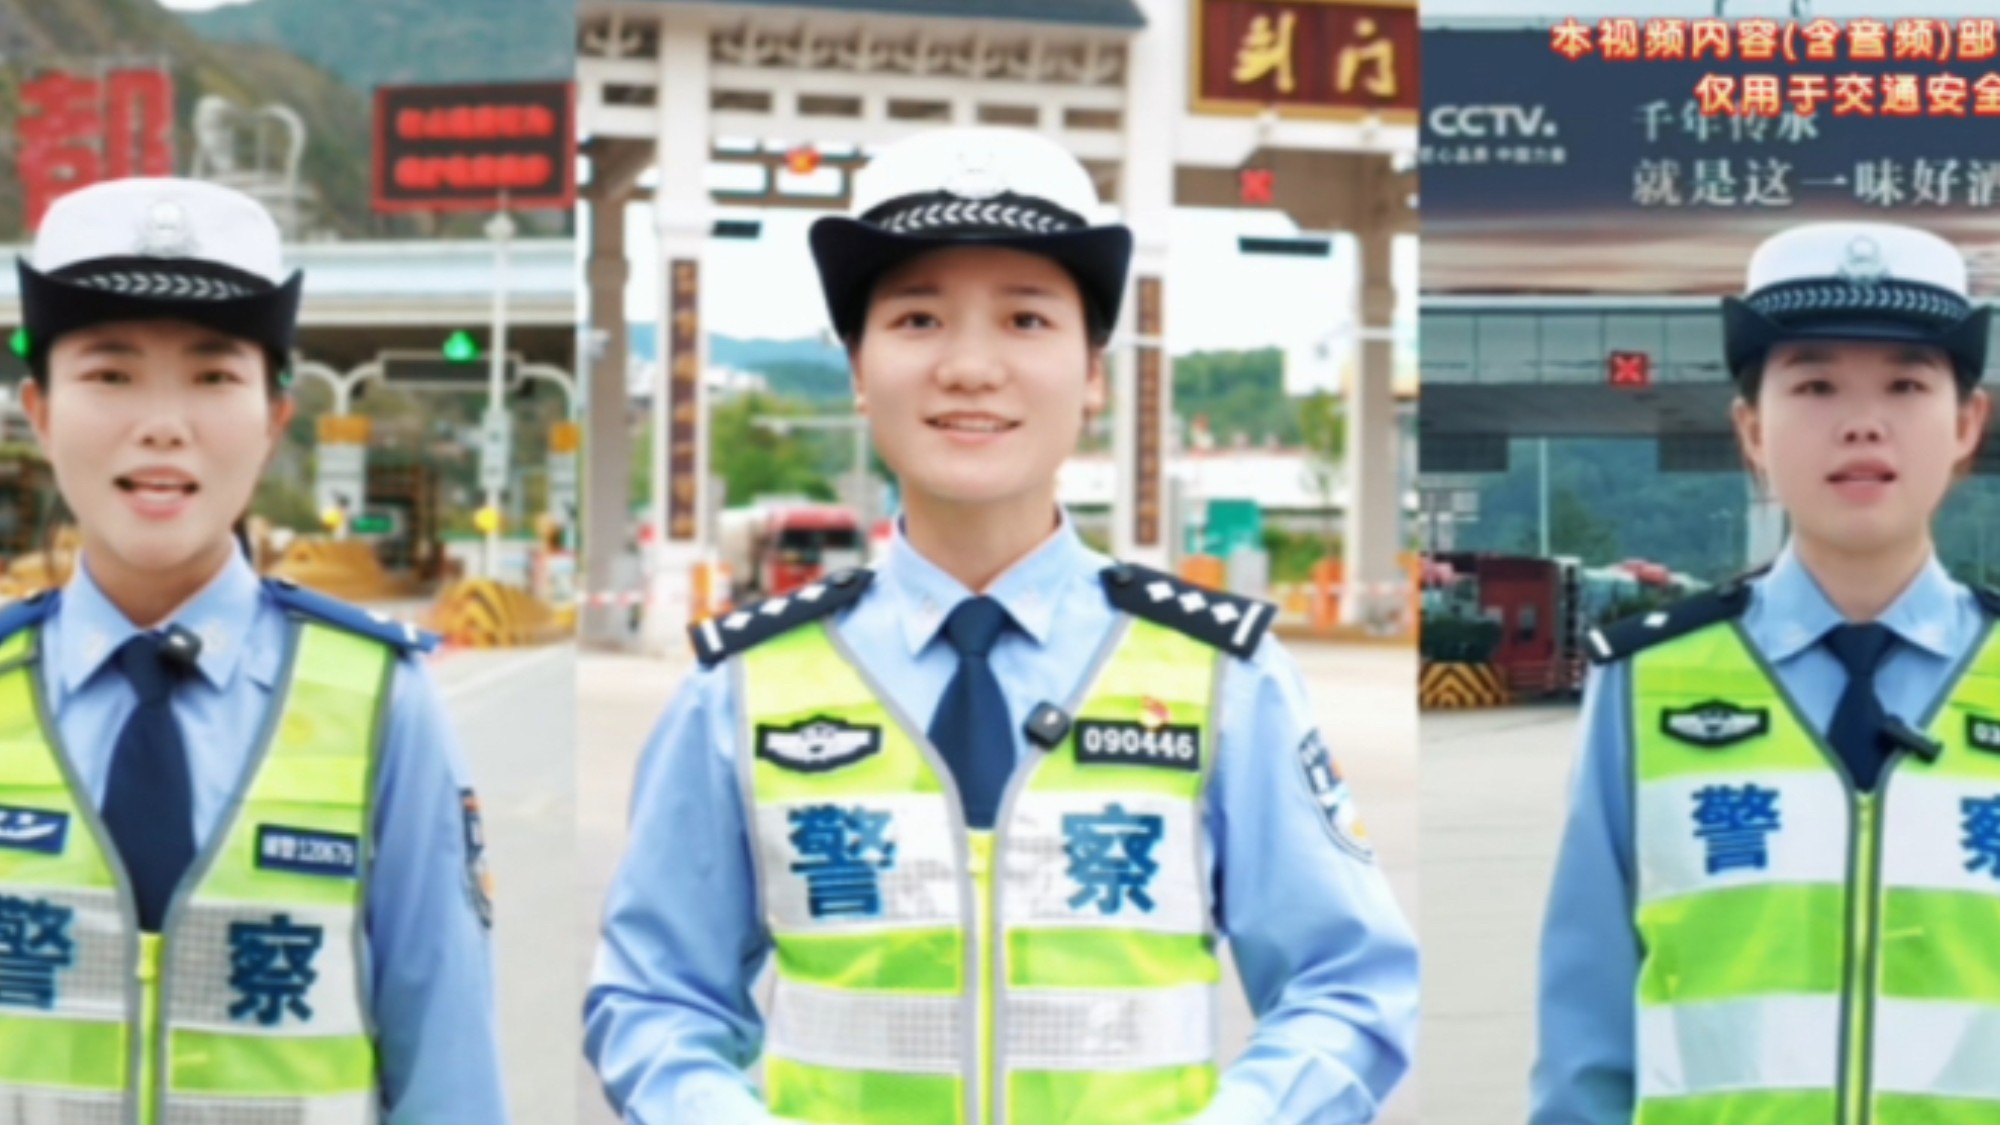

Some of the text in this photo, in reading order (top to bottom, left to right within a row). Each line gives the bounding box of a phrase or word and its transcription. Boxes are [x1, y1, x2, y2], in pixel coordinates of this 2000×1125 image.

[1632, 157, 2000, 207] 就是这一味好酒
[1083, 727, 1196, 760] 090446
[788, 802, 1165, 918] 警 察
[227, 914, 324, 1026] 察
